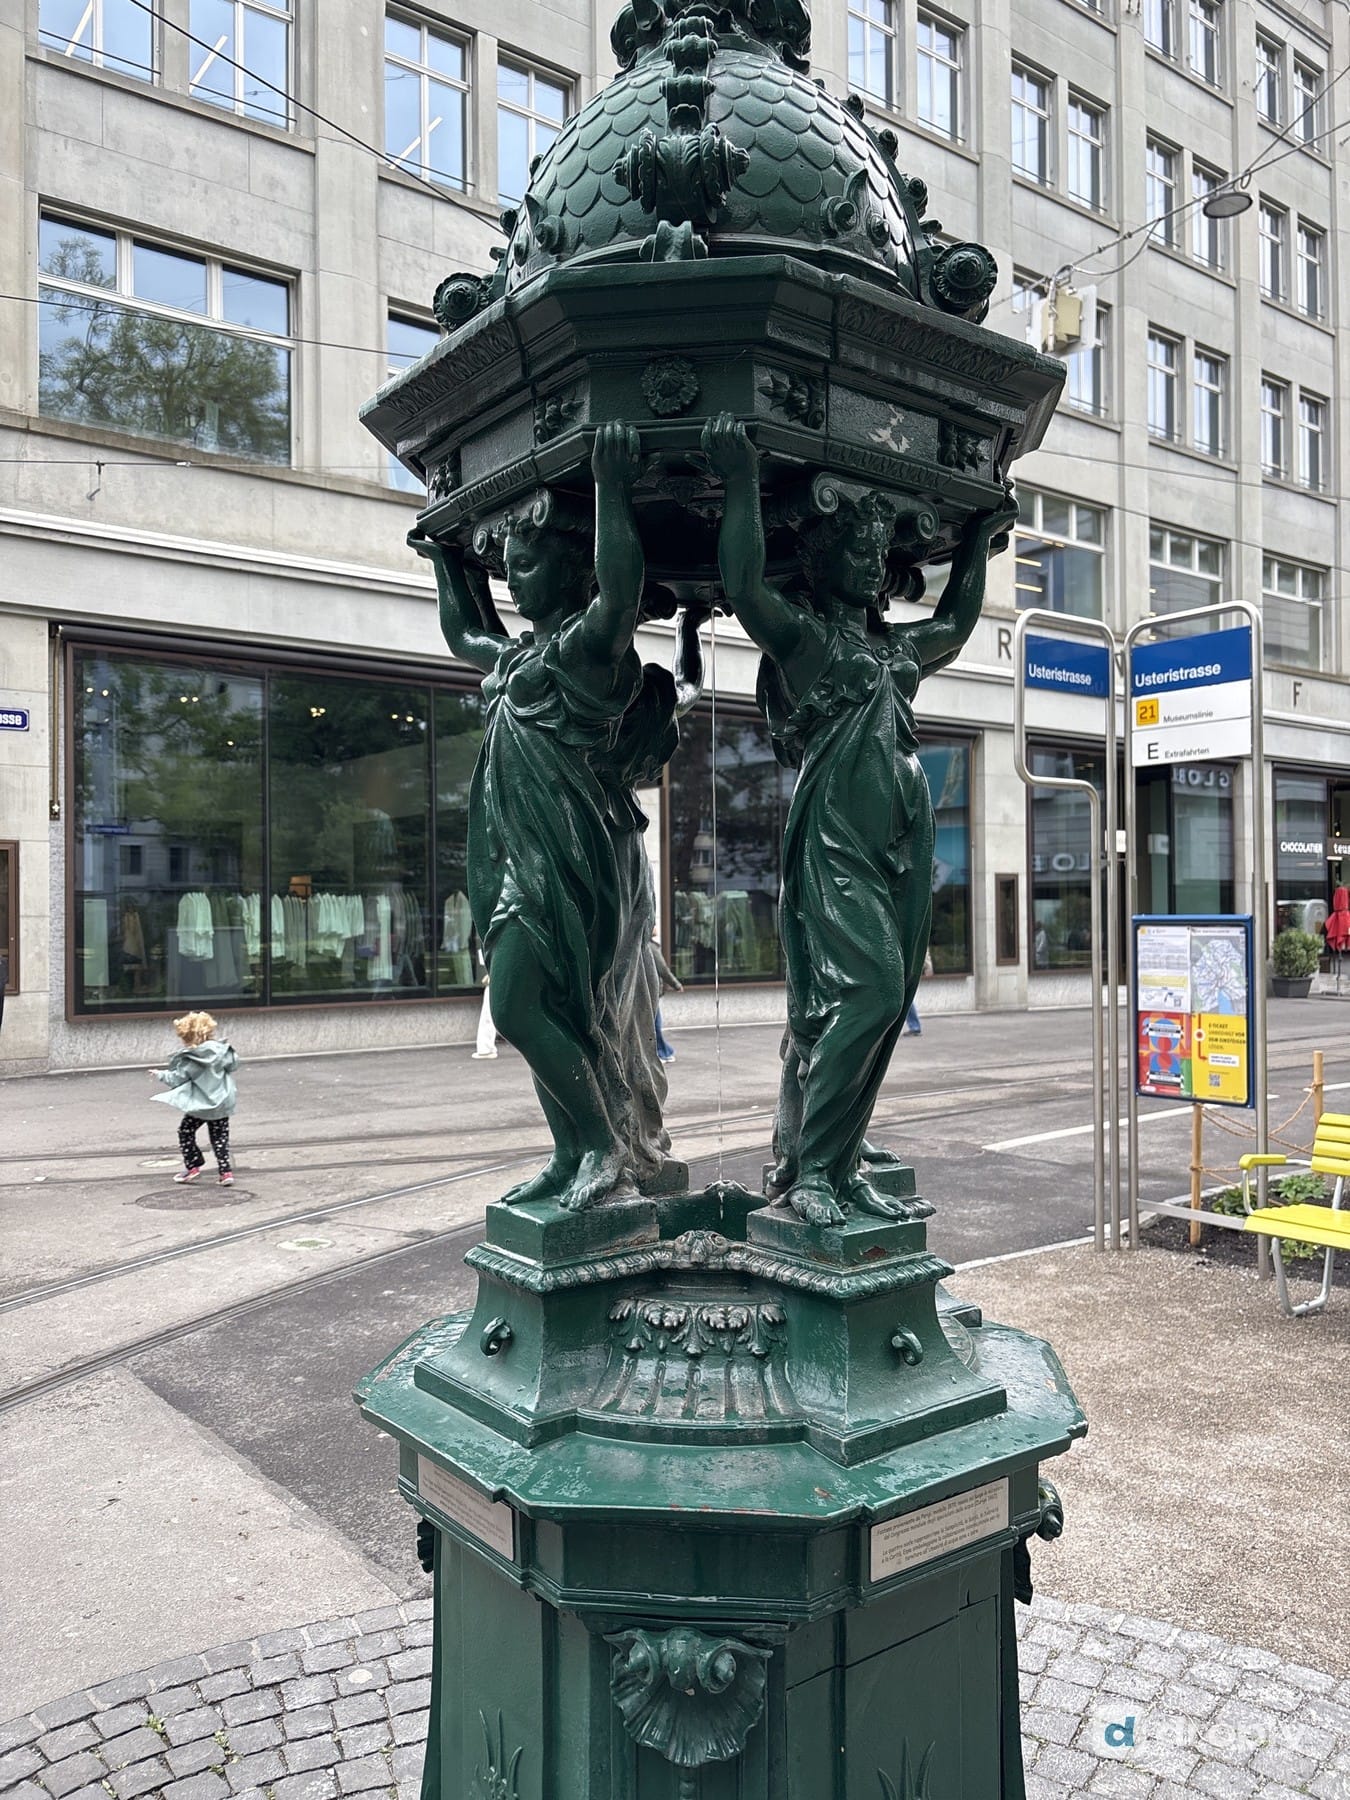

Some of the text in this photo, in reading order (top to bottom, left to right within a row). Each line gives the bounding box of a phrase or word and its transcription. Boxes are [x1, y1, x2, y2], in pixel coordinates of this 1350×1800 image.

[1028, 663, 1092, 686] Usteristrasse
[1135, 663, 1221, 688] Usteristrasse
[1140, 704, 1214, 723] 21 Museumslinie
[1147, 742, 1210, 760] E Extrafahrten
